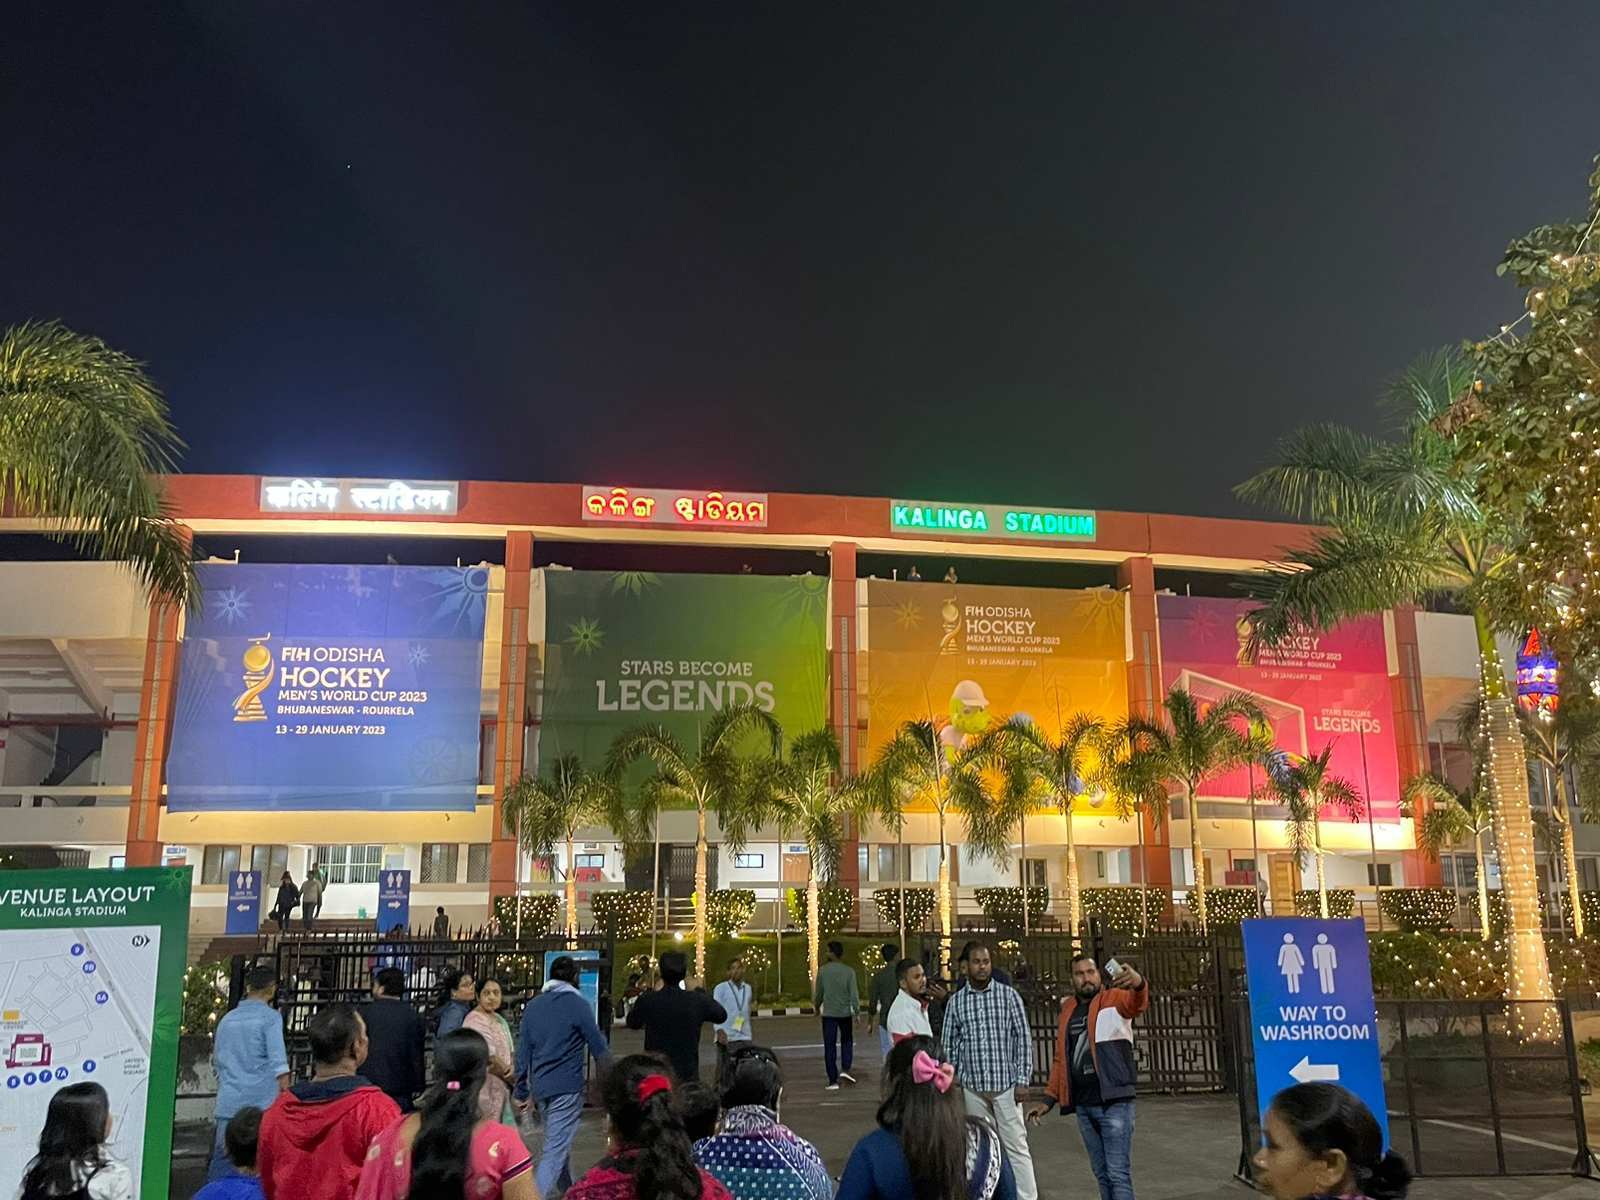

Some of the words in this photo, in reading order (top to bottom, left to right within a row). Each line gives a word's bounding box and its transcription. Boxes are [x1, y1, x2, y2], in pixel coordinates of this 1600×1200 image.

[894, 506, 987, 530] KALINGA
[1005, 512, 1094, 535] STADIUM
[985, 606, 1032, 618] ODISHA
[965, 619, 1036, 635] HOCKEY
[993, 635, 1024, 644] WORLD
[1025, 636, 1041, 644] CUP
[281, 647, 311, 662] FIH
[313, 647, 385, 662] ODISHA
[1311, 651, 1325, 660] CUP
[621, 660, 674, 676] STARS
[679, 661, 753, 676] BECOME
[280, 667, 390, 688] HOCKEY
[278, 689, 318, 701] MEN'S
[320, 690, 369, 701] WORLD
[371, 690, 397, 701] CUP
[399, 691, 428, 702] 2023
[596, 679, 776, 713] LEGENDS
[277, 705, 354, 715] BHUBANESWAR
[362, 706, 415, 716] ROURKELA
[275, 725, 287, 734] 13
[295, 725, 308, 734] 29
[309, 725, 361, 735] JANUARY
[362, 726, 386, 735] 2023
[1312, 716, 1381, 734] LEGENDS
[72, 886, 156, 904] LAYOUT
[20, 907, 72, 918] KALINGA
[74, 905, 127, 917] STADIUM
[1279, 1006, 1318, 1021] WAY
[1322, 1005, 1346, 1021] TO
[1260, 1024, 1370, 1041] WASHROOM
